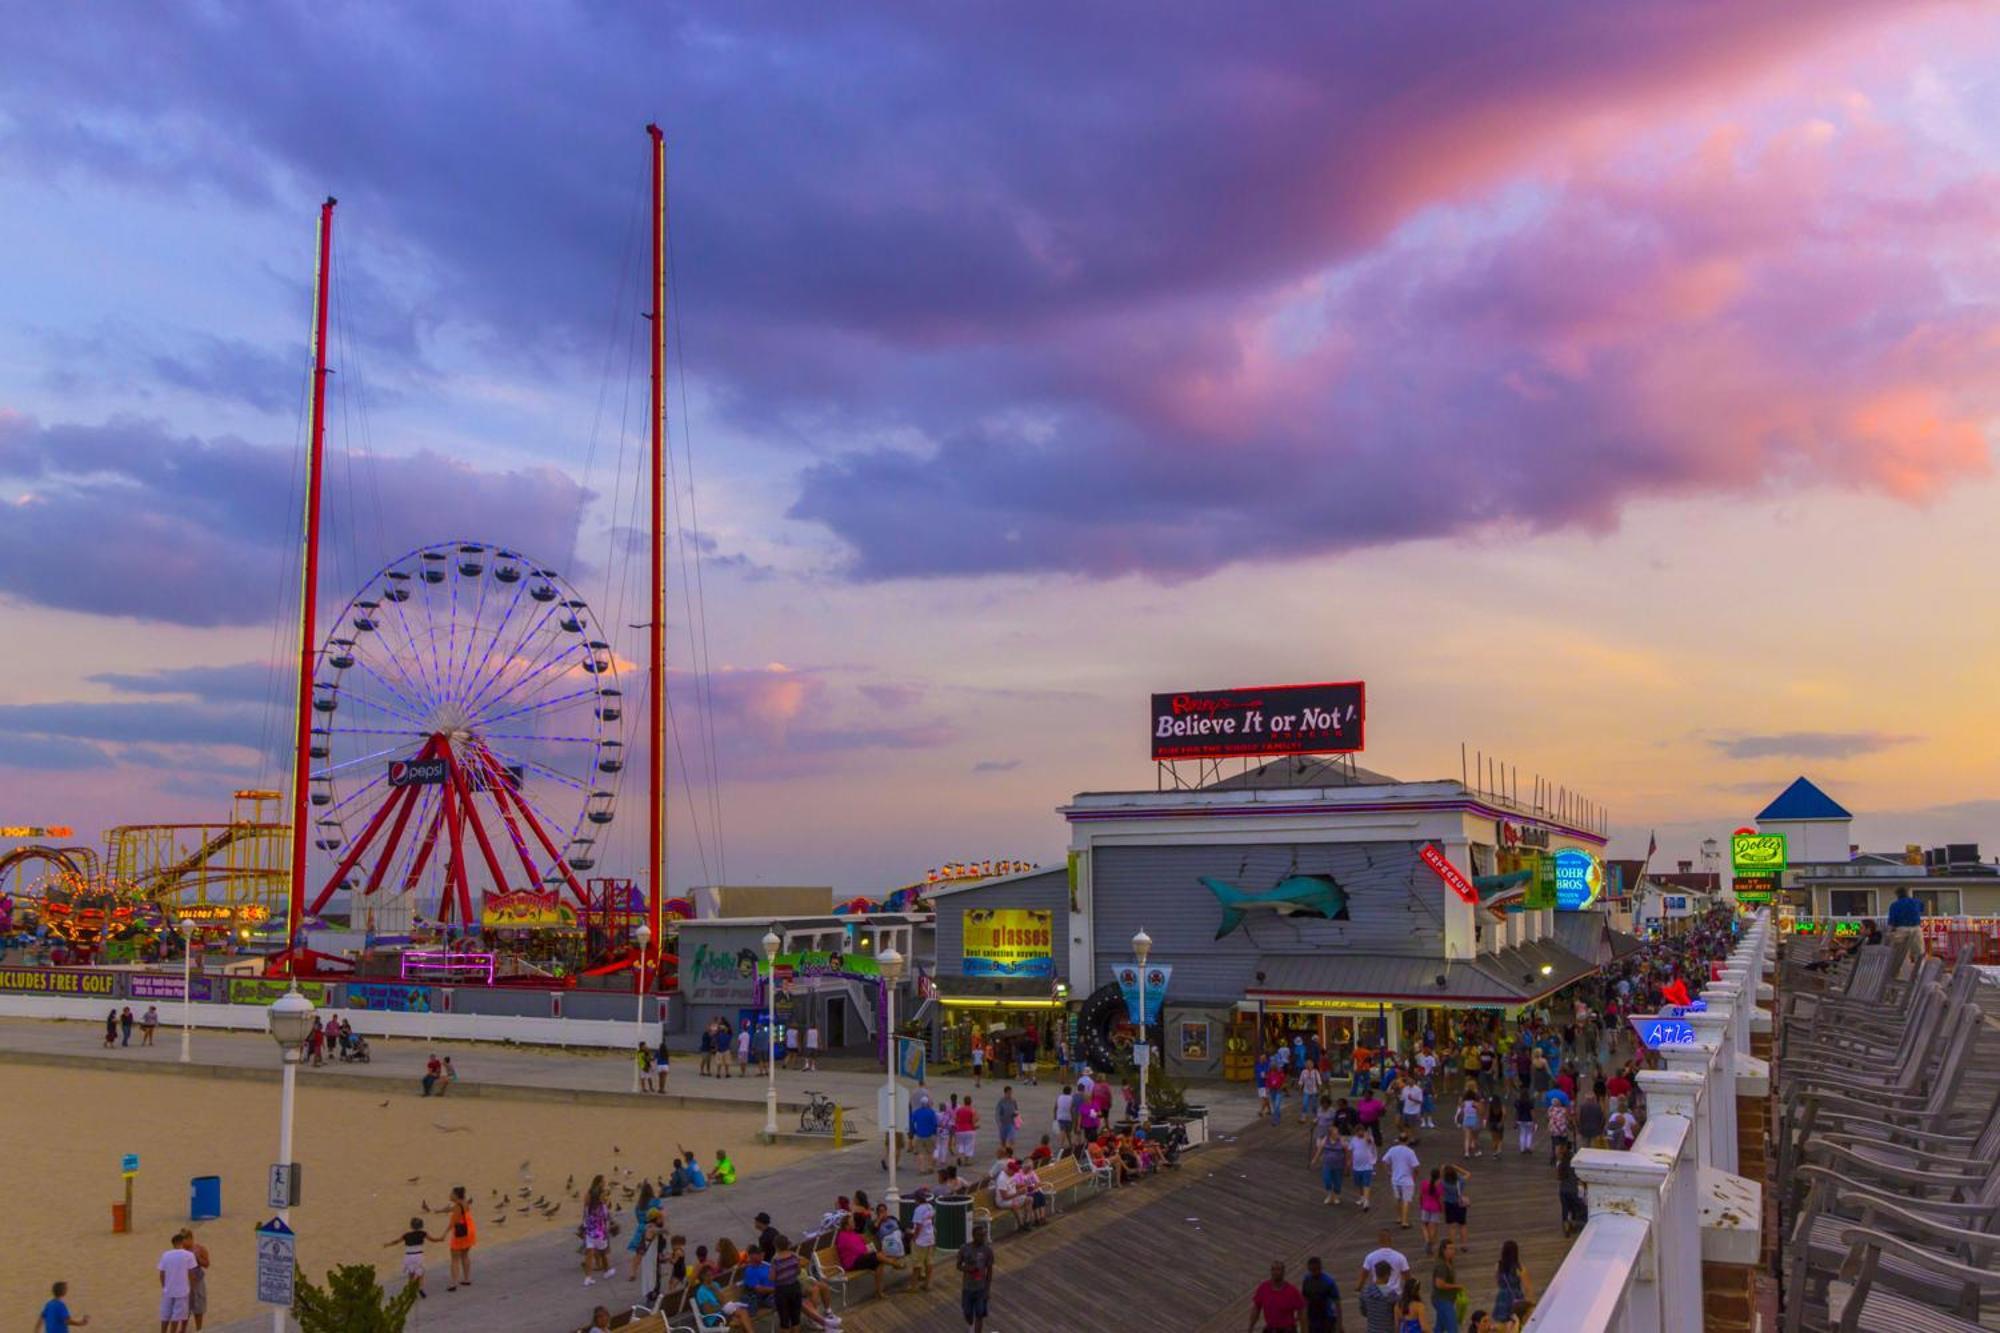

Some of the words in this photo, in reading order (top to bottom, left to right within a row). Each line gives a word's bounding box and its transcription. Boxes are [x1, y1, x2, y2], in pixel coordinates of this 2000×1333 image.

[1156, 713, 1236, 738] Believe
[1241, 710, 1264, 733] It
[1270, 713, 1296, 732] or
[408, 763, 442, 780] pepsi
[1425, 849, 1470, 894] ENTRANCE
[1556, 879, 1583, 890] BROS
[49, 973, 78, 991] FREE
[82, 975, 113, 993] GOLF
